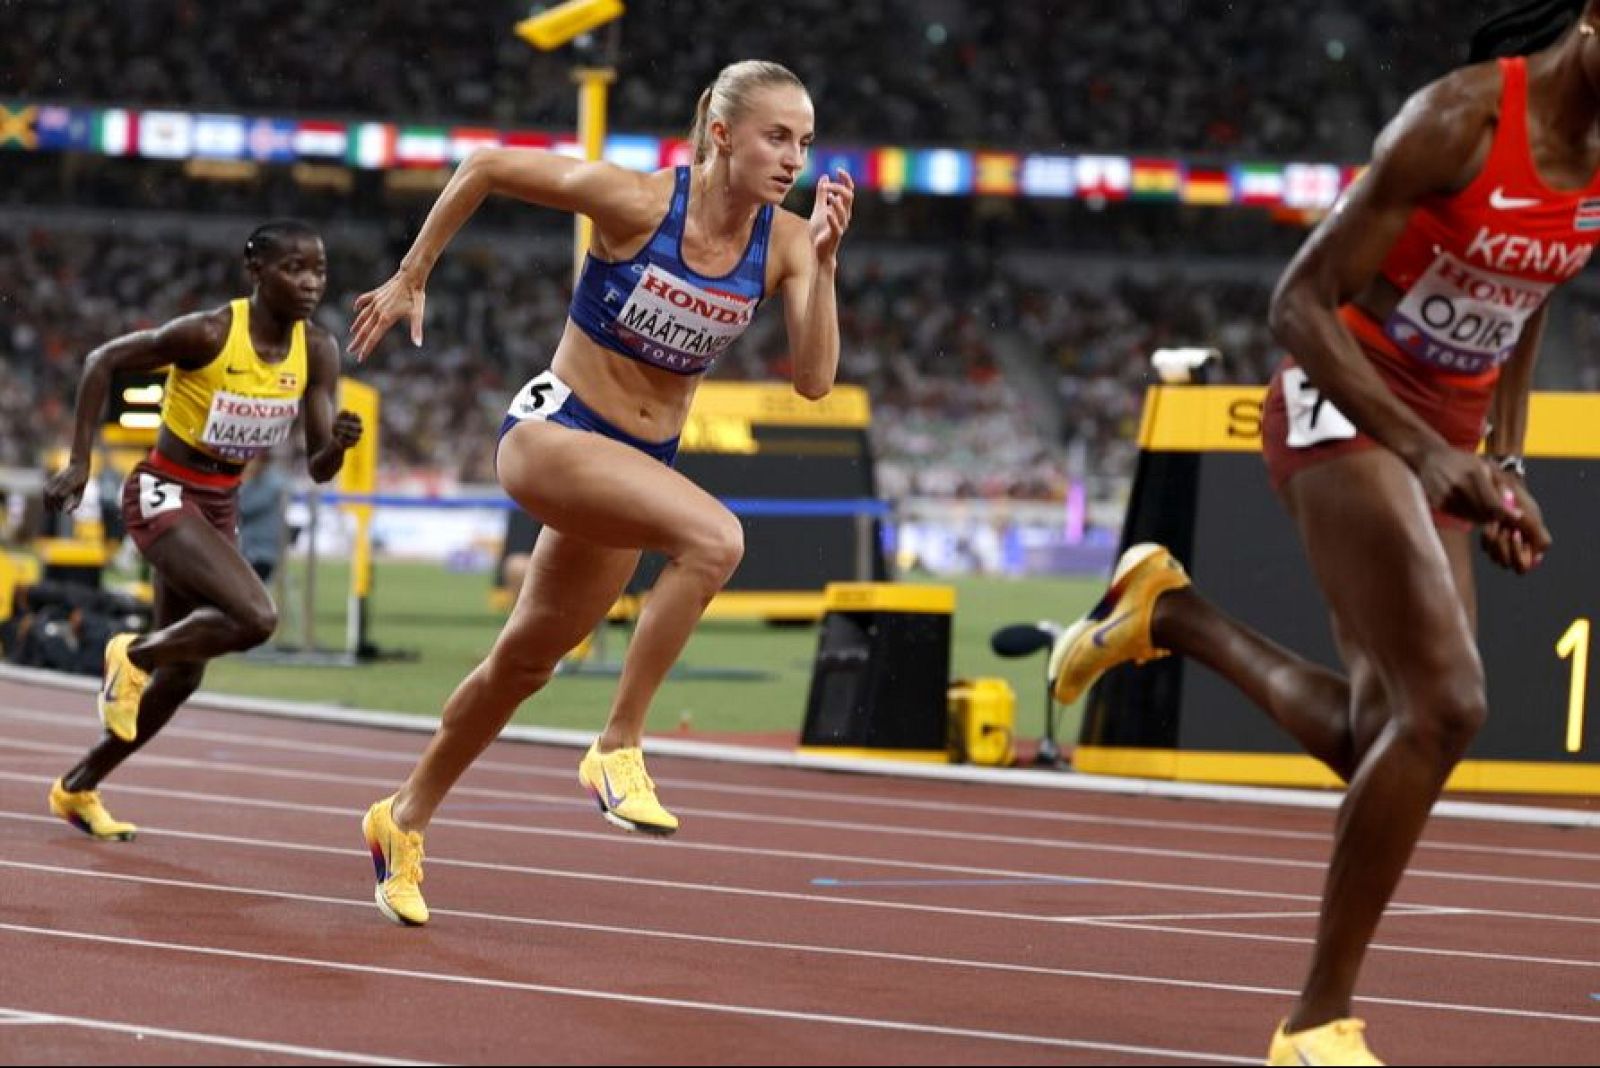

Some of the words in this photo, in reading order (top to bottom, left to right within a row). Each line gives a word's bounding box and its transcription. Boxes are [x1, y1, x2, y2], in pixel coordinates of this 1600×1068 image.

[642, 273, 748, 326] HONDA
[1438, 261, 1544, 309] HOND
[623, 302, 731, 353] MÄÄTTÄN
[642, 343, 693, 368] TOKY
[1426, 344, 1481, 370] TOKY
[217, 398, 296, 418] HONDA
[530, 382, 553, 409] 5
[150, 480, 167, 509] 5
[1556, 618, 1590, 752] 1
